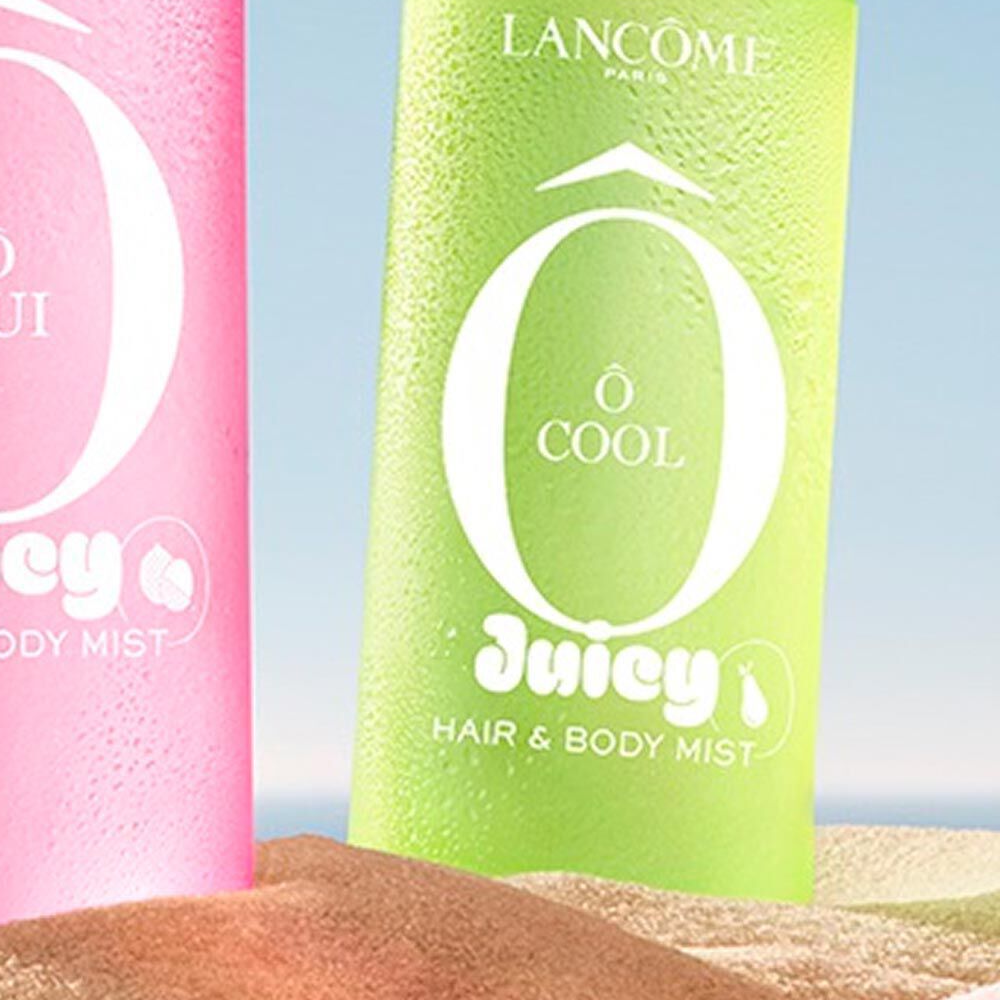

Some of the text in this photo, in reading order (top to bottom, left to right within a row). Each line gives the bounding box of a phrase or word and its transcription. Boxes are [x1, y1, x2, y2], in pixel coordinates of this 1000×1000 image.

[503, 13, 775, 77] LANCÔME
[605, 67, 667, 84] PARIS
[442, 141, 787, 638] Ô
[595, 362, 634, 413] Ô
[538, 421, 685, 468] COOL
[82, 628, 169, 657] MIST
[474, 613, 720, 727] Juicy
[432, 717, 757, 768] HAIR & BODY MIST
